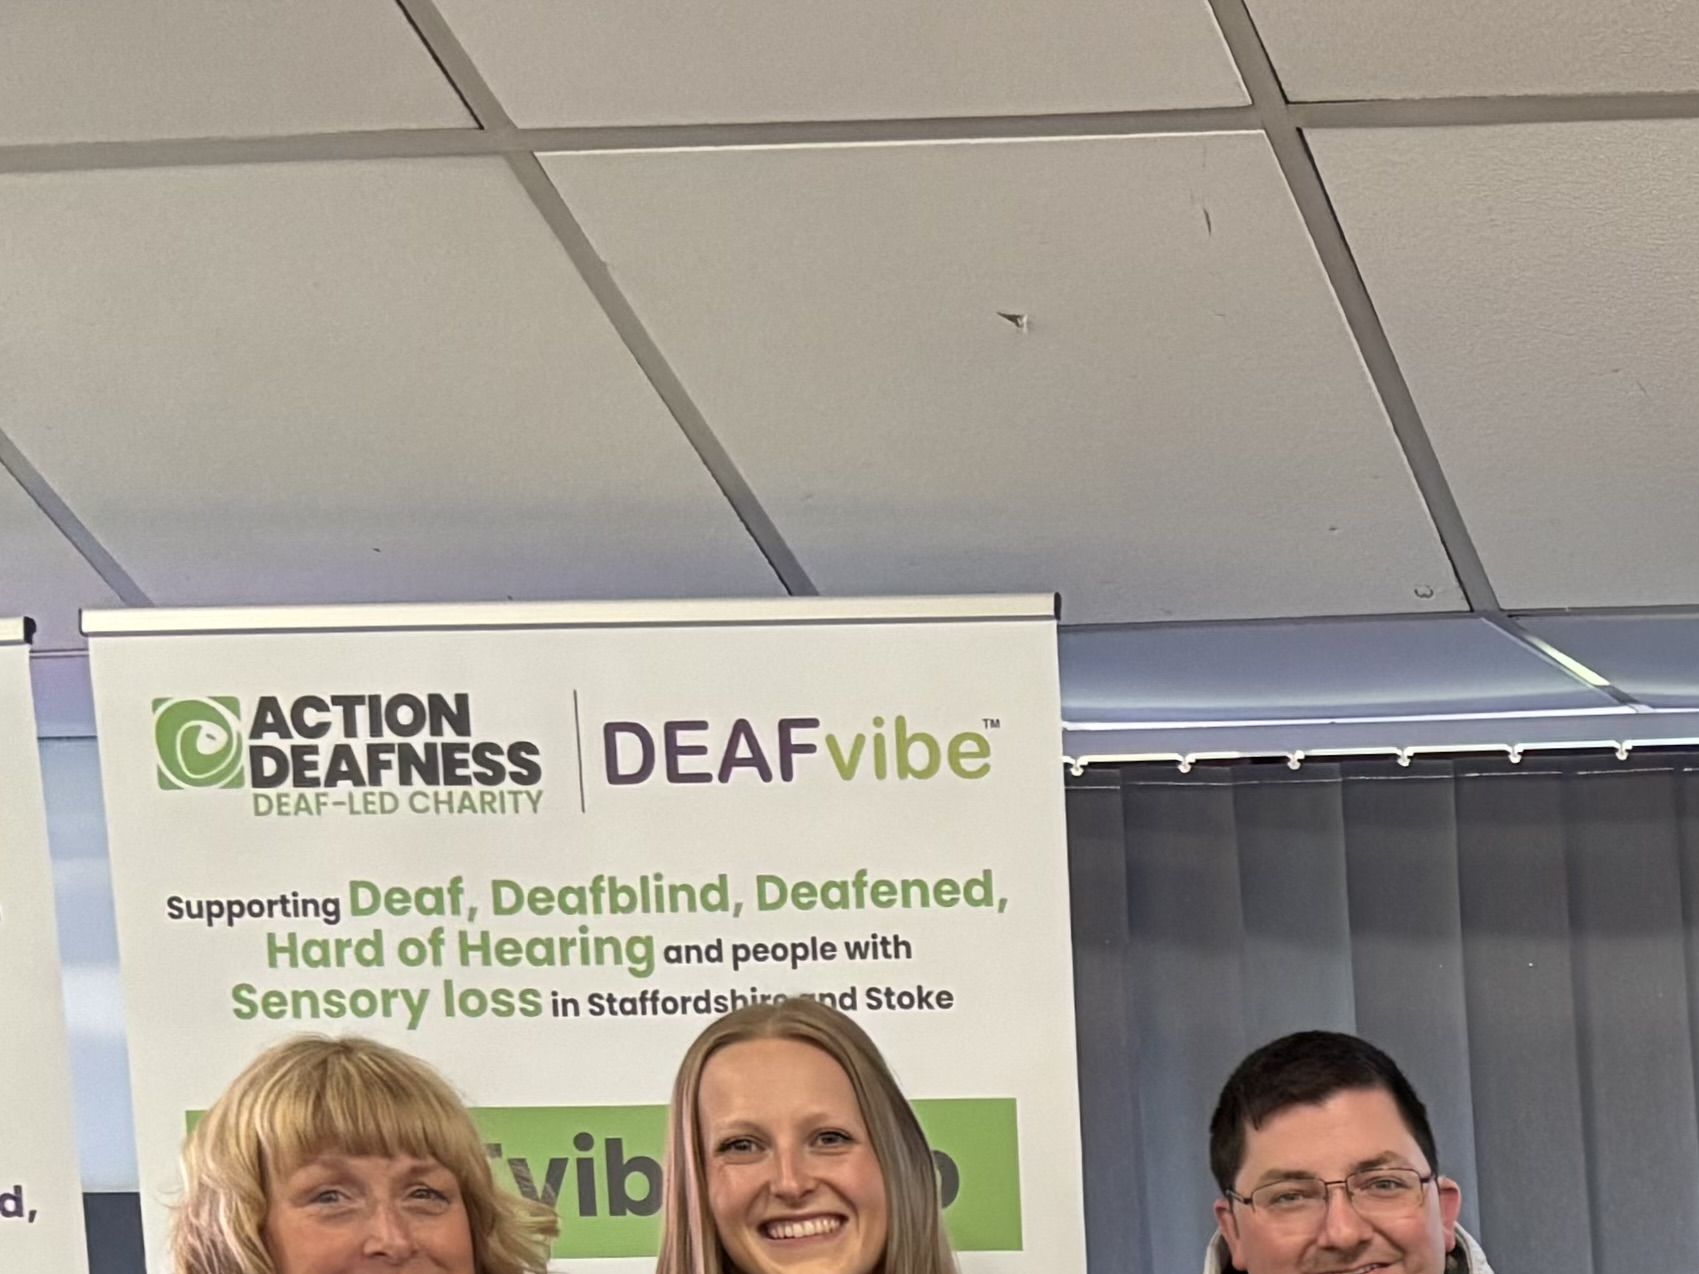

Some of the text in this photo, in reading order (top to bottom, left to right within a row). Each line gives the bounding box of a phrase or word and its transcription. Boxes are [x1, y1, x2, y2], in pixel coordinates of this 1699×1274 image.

[250, 692, 471, 738] ACTION
[248, 741, 542, 789] DEAFNESS
[253, 789, 543, 817] DEAF-LED CHARITY
[166, 870, 1007, 925] Supporting Deaf, Deafblind, Deafened,
[266, 925, 912, 975] Hard of Hearing and people with
[232, 986, 430, 1029] Sensory
[443, 980, 542, 1020] loss
[551, 992, 580, 1016] in
[865, 982, 954, 1011] Stoke
